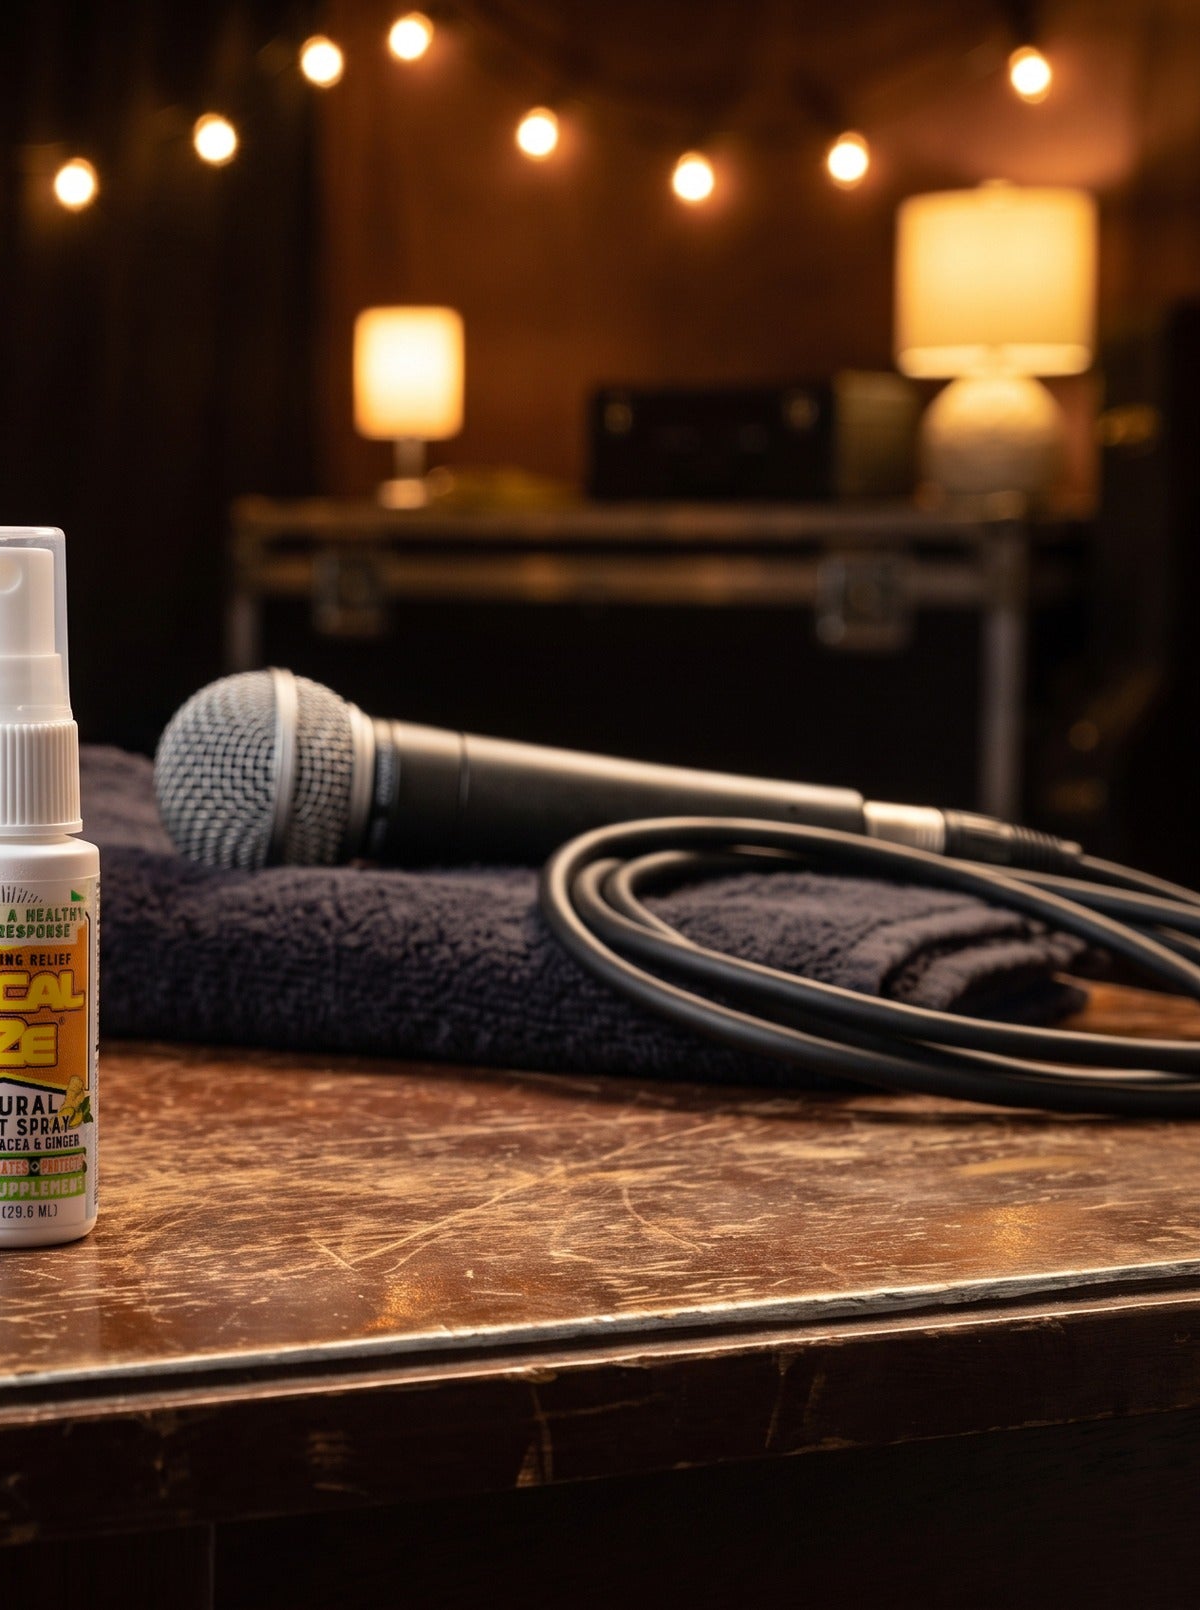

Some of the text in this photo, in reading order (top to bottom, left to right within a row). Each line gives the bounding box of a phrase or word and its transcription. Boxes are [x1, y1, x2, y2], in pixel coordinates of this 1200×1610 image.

[7, 909, 18, 922] A
[30, 952, 71, 966] RELIEF
[17, 1115, 70, 1136] SPRAY
[34, 1138, 42, 1150] &
[45, 1134, 80, 1149] GINGER
[2, 1206, 33, 1219] (29.6
[38, 1204, 58, 1218] ML)
